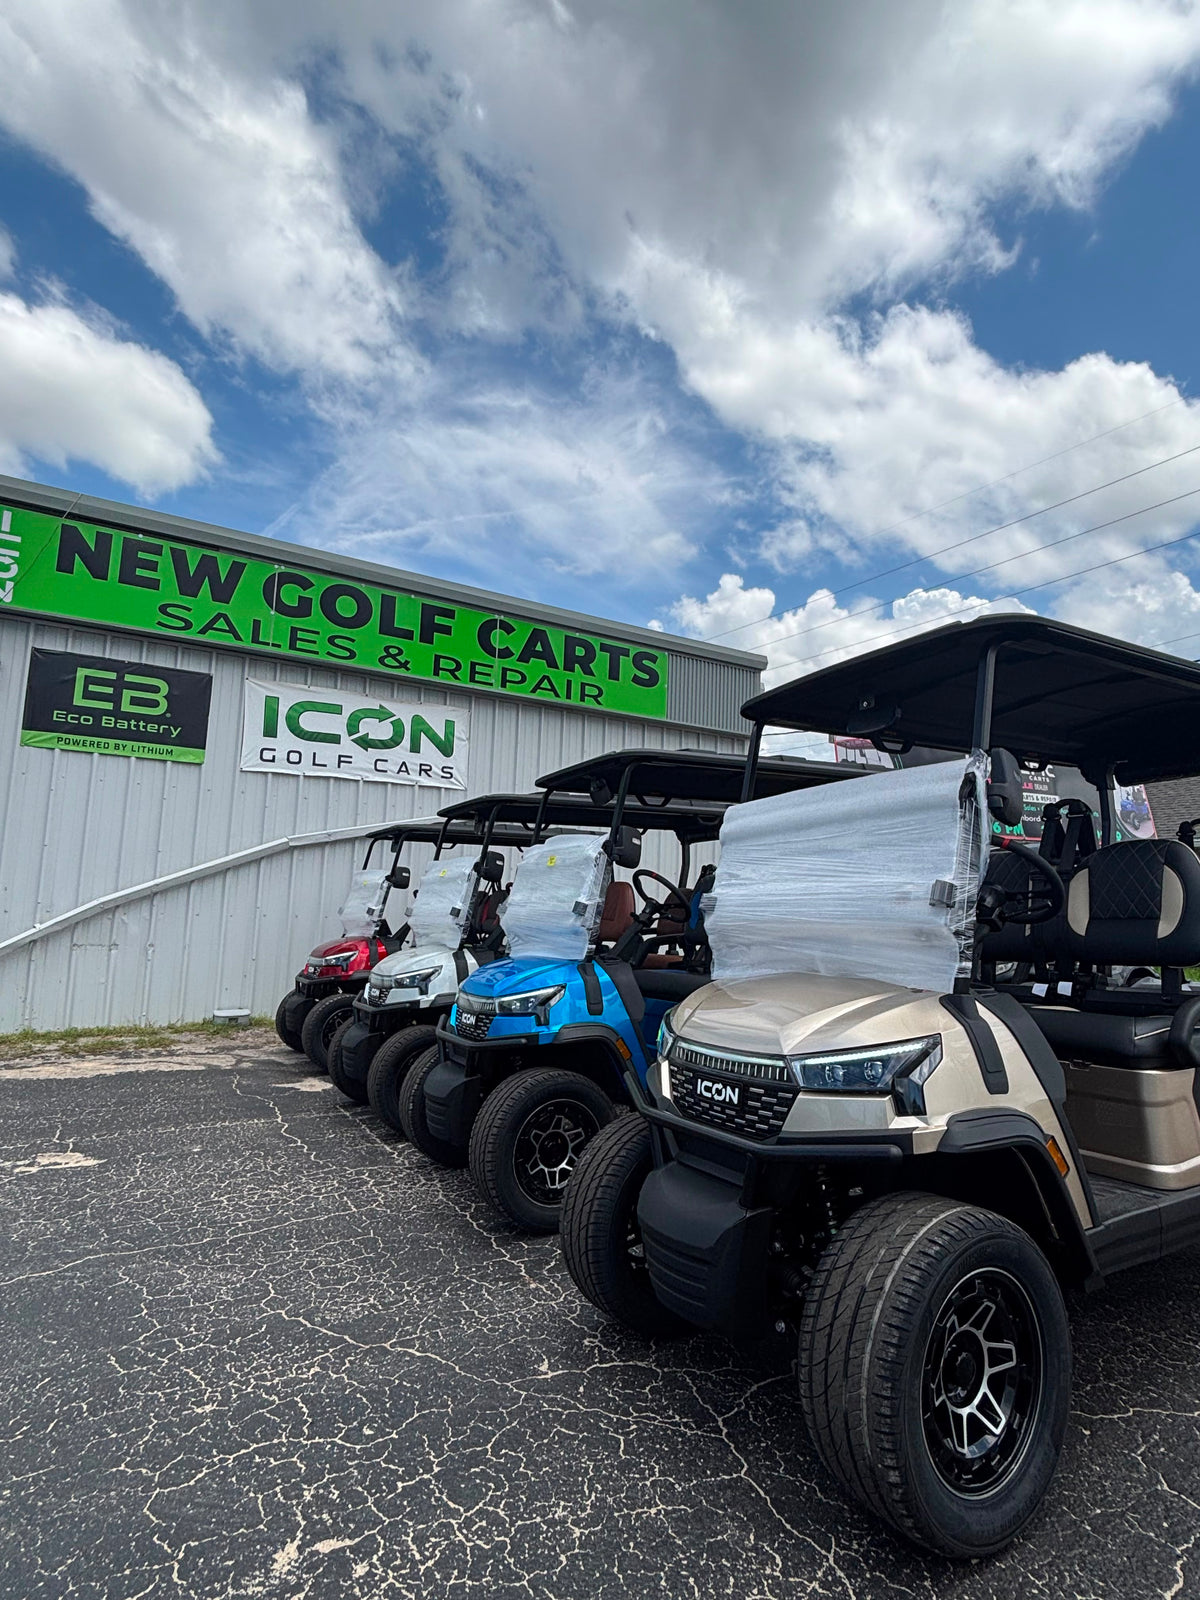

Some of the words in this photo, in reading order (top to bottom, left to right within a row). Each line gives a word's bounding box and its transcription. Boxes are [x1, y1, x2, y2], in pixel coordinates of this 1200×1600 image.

[55, 523, 247, 605] NEW
[262, 571, 456, 647] GOLF
[476, 617, 659, 689] CARTS
[155, 603, 357, 661] SALES
[378, 644, 411, 673] &
[432, 653, 604, 706] REPAIR
[73, 668, 170, 715] EB
[52, 709, 94, 727] Eco
[101, 715, 182, 739] Battery
[262, 695, 456, 758] ICON
[56, 736, 110, 751] POWERED
[113, 742, 128, 753] BY
[130, 744, 174, 757] LITHIUM
[259, 747, 354, 769] GOLF
[373, 757, 455, 780] CARS
[1022, 793, 1035, 801] ARTS
[993, 822, 1002, 834] 6
[461, 1012, 476, 1026] ICON
[696, 1078, 739, 1105] ICON
